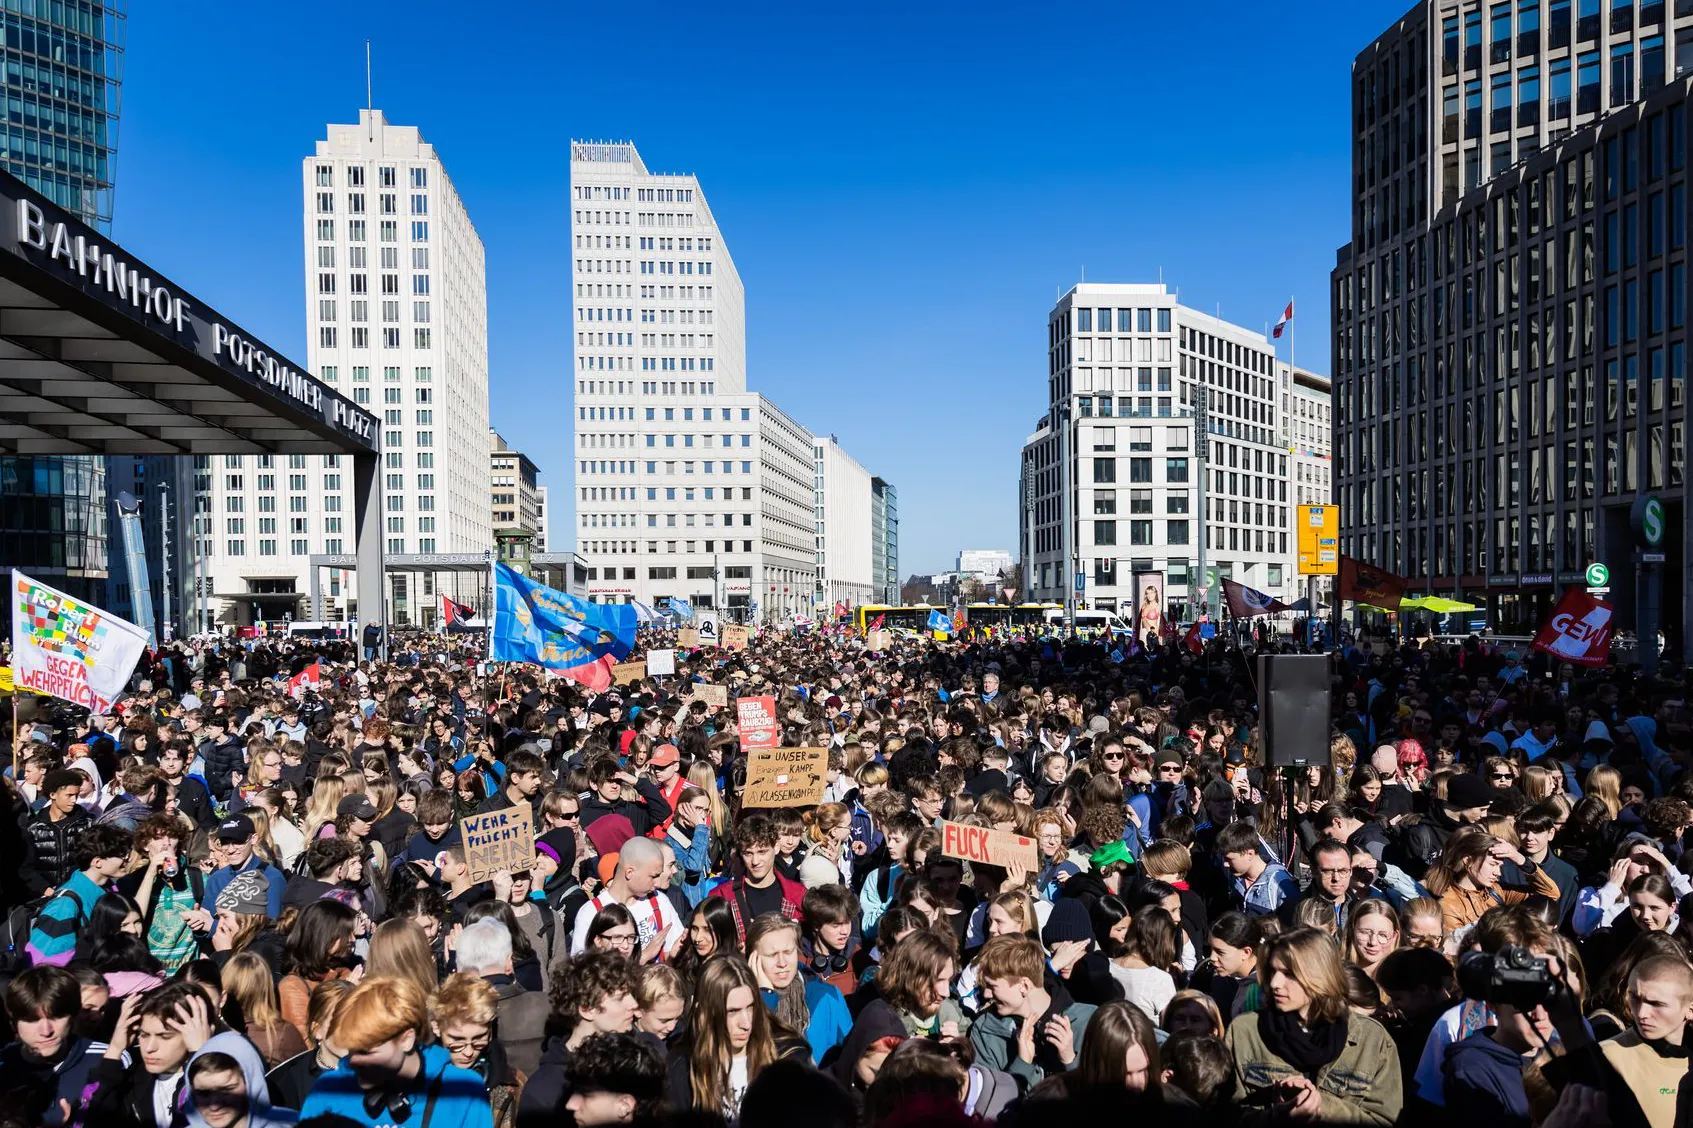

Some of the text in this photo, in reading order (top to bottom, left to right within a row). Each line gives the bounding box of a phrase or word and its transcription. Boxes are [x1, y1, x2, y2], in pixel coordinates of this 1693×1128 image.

[17, 198, 372, 440] BAHNHOF POTSDAMER PLATZ
[1645, 499, 1662, 543] S
[1591, 566, 1606, 585] S
[31, 589, 97, 626] Robert
[1551, 612, 1609, 647] GEW
[46, 655, 87, 682] GEGEN
[20, 666, 110, 715] WEHRPFLICHT
[739, 701, 762, 711] GEGEN
[740, 709, 768, 719] TRUMPS
[740, 717, 774, 727] RAUBZUG!
[775, 751, 807, 761] UNSER
[789, 763, 814, 774] KAMPF
[470, 837, 530, 869] NEIN
[945, 825, 990, 863] FUCK
[473, 858, 533, 881] DANKE
